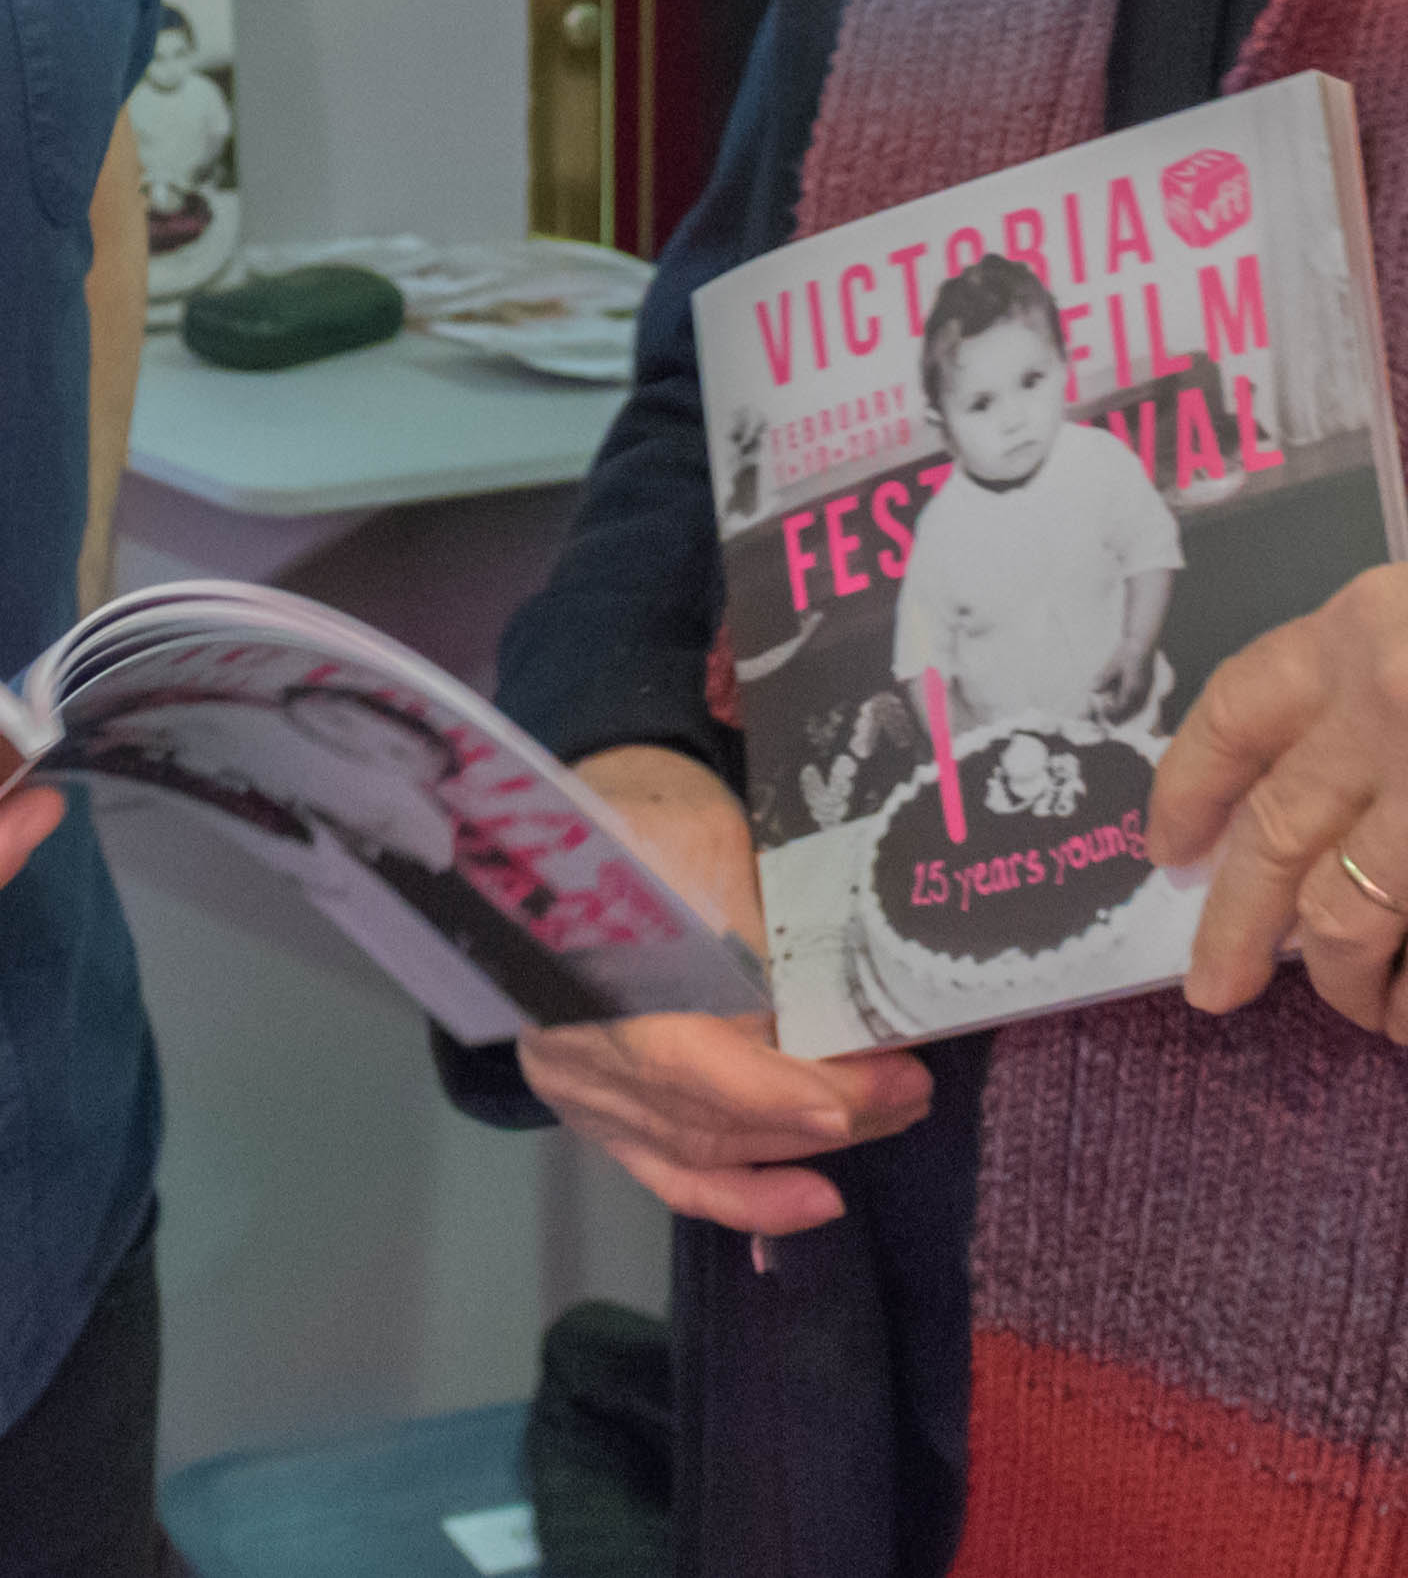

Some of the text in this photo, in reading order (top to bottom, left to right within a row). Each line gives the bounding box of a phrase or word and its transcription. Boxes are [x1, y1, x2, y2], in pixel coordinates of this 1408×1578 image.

[1059, 253, 1271, 403] FILM
[782, 375, 1285, 613] FESVAL
[953, 848, 1047, 913] years
